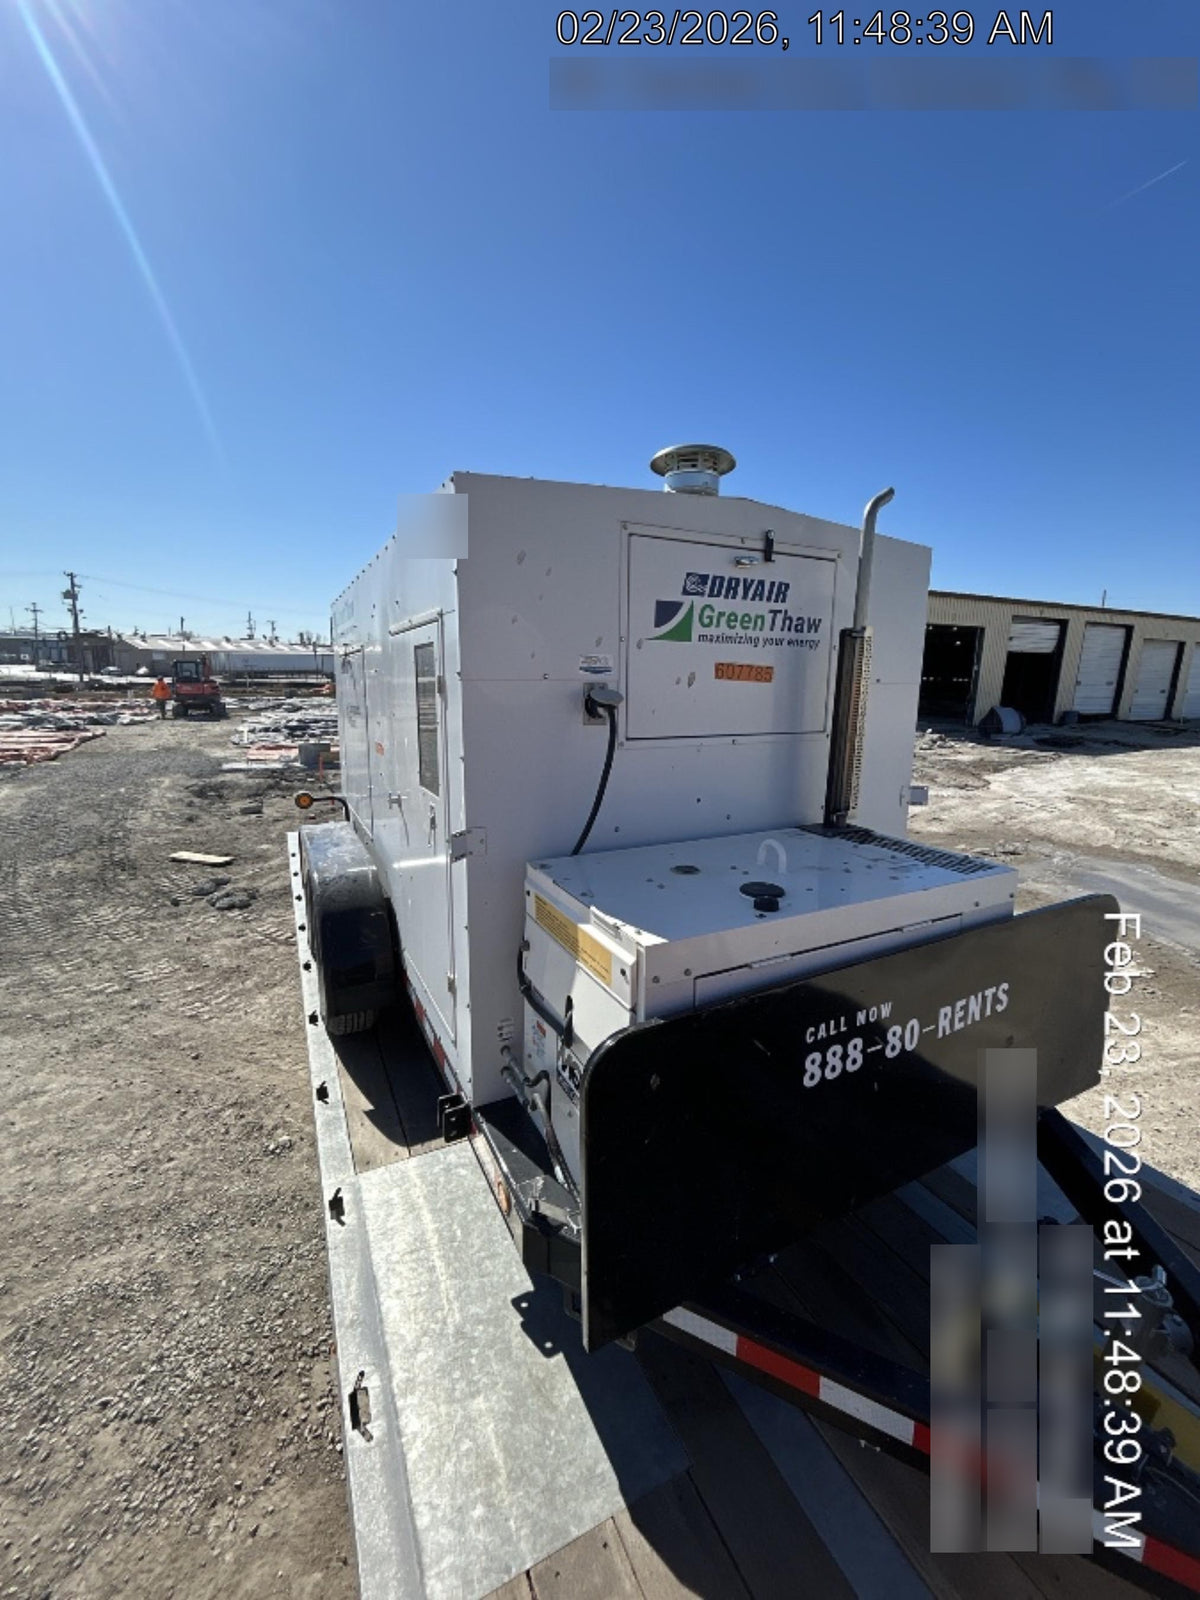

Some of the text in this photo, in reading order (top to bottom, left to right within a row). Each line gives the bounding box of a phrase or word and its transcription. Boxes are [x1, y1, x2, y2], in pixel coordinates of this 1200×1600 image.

[707, 574, 790, 604] DRYAIR
[697, 632, 821, 651] maximizing your energy
[802, 982, 1010, 1088] 888-80-RENTS
[805, 1001, 893, 1044] CALL NOW
